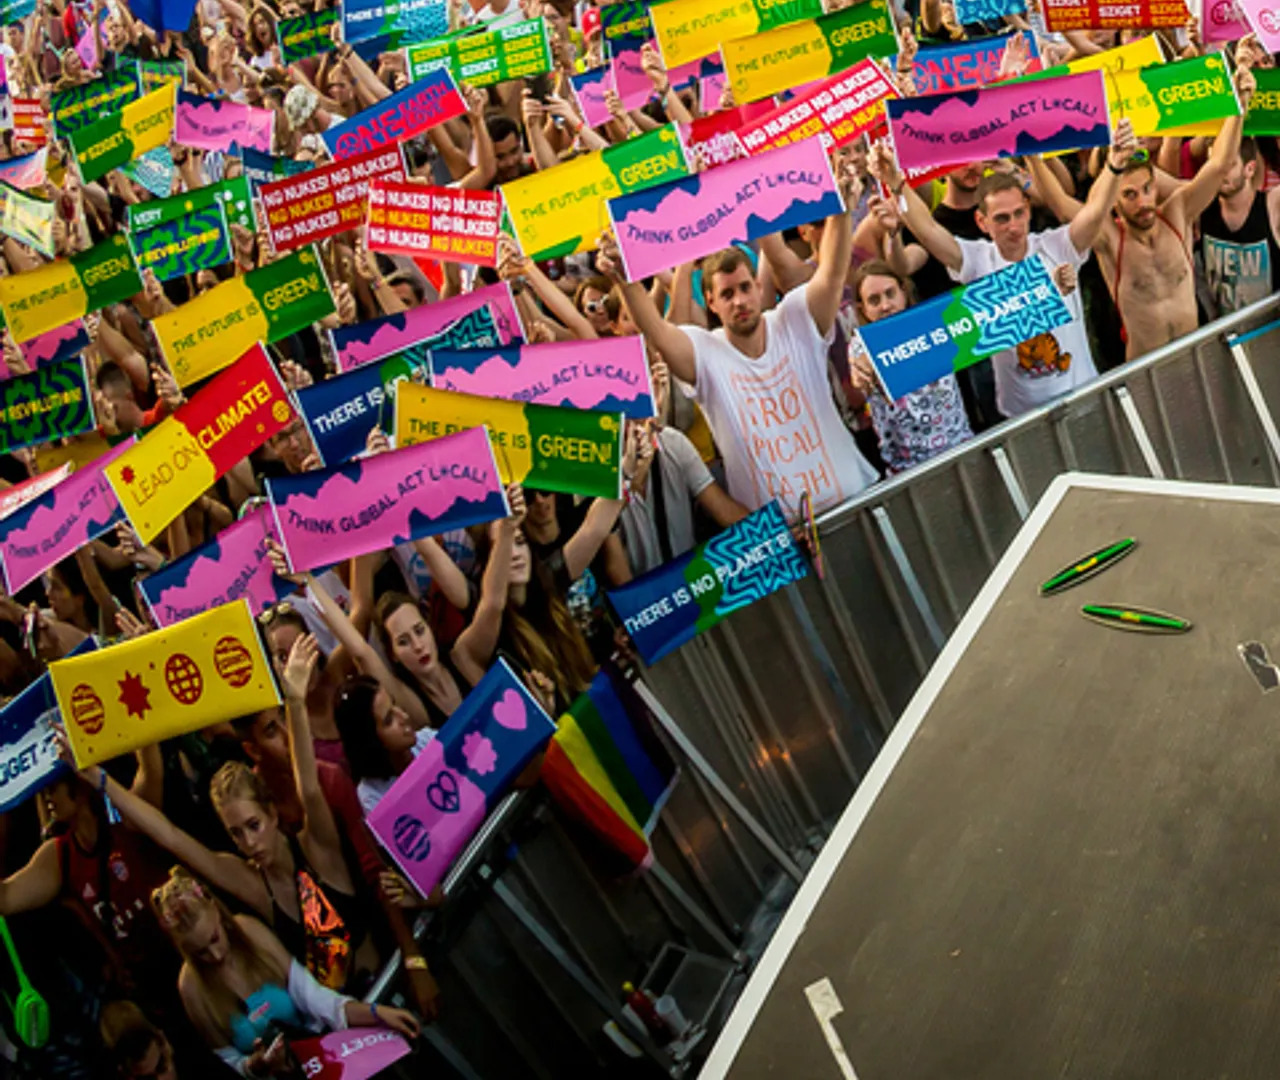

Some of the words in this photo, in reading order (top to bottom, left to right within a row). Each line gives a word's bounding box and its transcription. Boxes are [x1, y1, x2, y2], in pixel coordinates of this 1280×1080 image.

[665, 22, 690, 41] THE
[693, 10, 738, 33] FUTURE
[739, 2, 752, 17] IS
[735, 56, 761, 75] THE
[764, 44, 810, 68] FUTURE
[812, 39, 827, 54] IS
[831, 18, 888, 49] GREEN!
[1157, 78, 1227, 107] GREEN!
[900, 122, 947, 144] THINK
[949, 115, 1008, 146] GLOBAL
[1010, 100, 1040, 122] ACT
[264, 189, 284, 208] NO
[284, 175, 329, 200] NUKES!
[330, 166, 350, 185] NO
[351, 152, 399, 177] NUKES!
[520, 201, 547, 221] THE
[549, 184, 599, 211] FUTURE
[600, 178, 614, 192] IS
[619, 152, 679, 186] GREEN!
[625, 224, 674, 243] THINK
[677, 204, 735, 241] GLOBAL
[735, 182, 764, 205] ACT
[172, 333, 196, 355] THE
[199, 314, 244, 346] FUTURE
[245, 302, 260, 317] IS
[264, 275, 322, 310] GREEN!
[876, 335, 930, 367] THERE
[930, 328, 946, 346] IS
[947, 318, 973, 339] NO
[973, 287, 1033, 326] PLANET
[313, 400, 368, 434] THERE
[368, 391, 388, 411] IS
[408, 418, 440, 436] THE
[513, 434, 527, 449] IS
[538, 436, 613, 465] GREEN!
[132, 468, 175, 509] LEAD
[174, 445, 202, 474] ON
[200, 380, 273, 450] CLIMATE!
[287, 507, 337, 534] THINK
[340, 492, 398, 535] GLOBAL
[399, 470, 429, 497] ACT
[623, 600, 674, 634] THERE
[674, 587, 690, 604] IS
[691, 573, 716, 597] NO
[715, 542, 771, 583] PLANET
